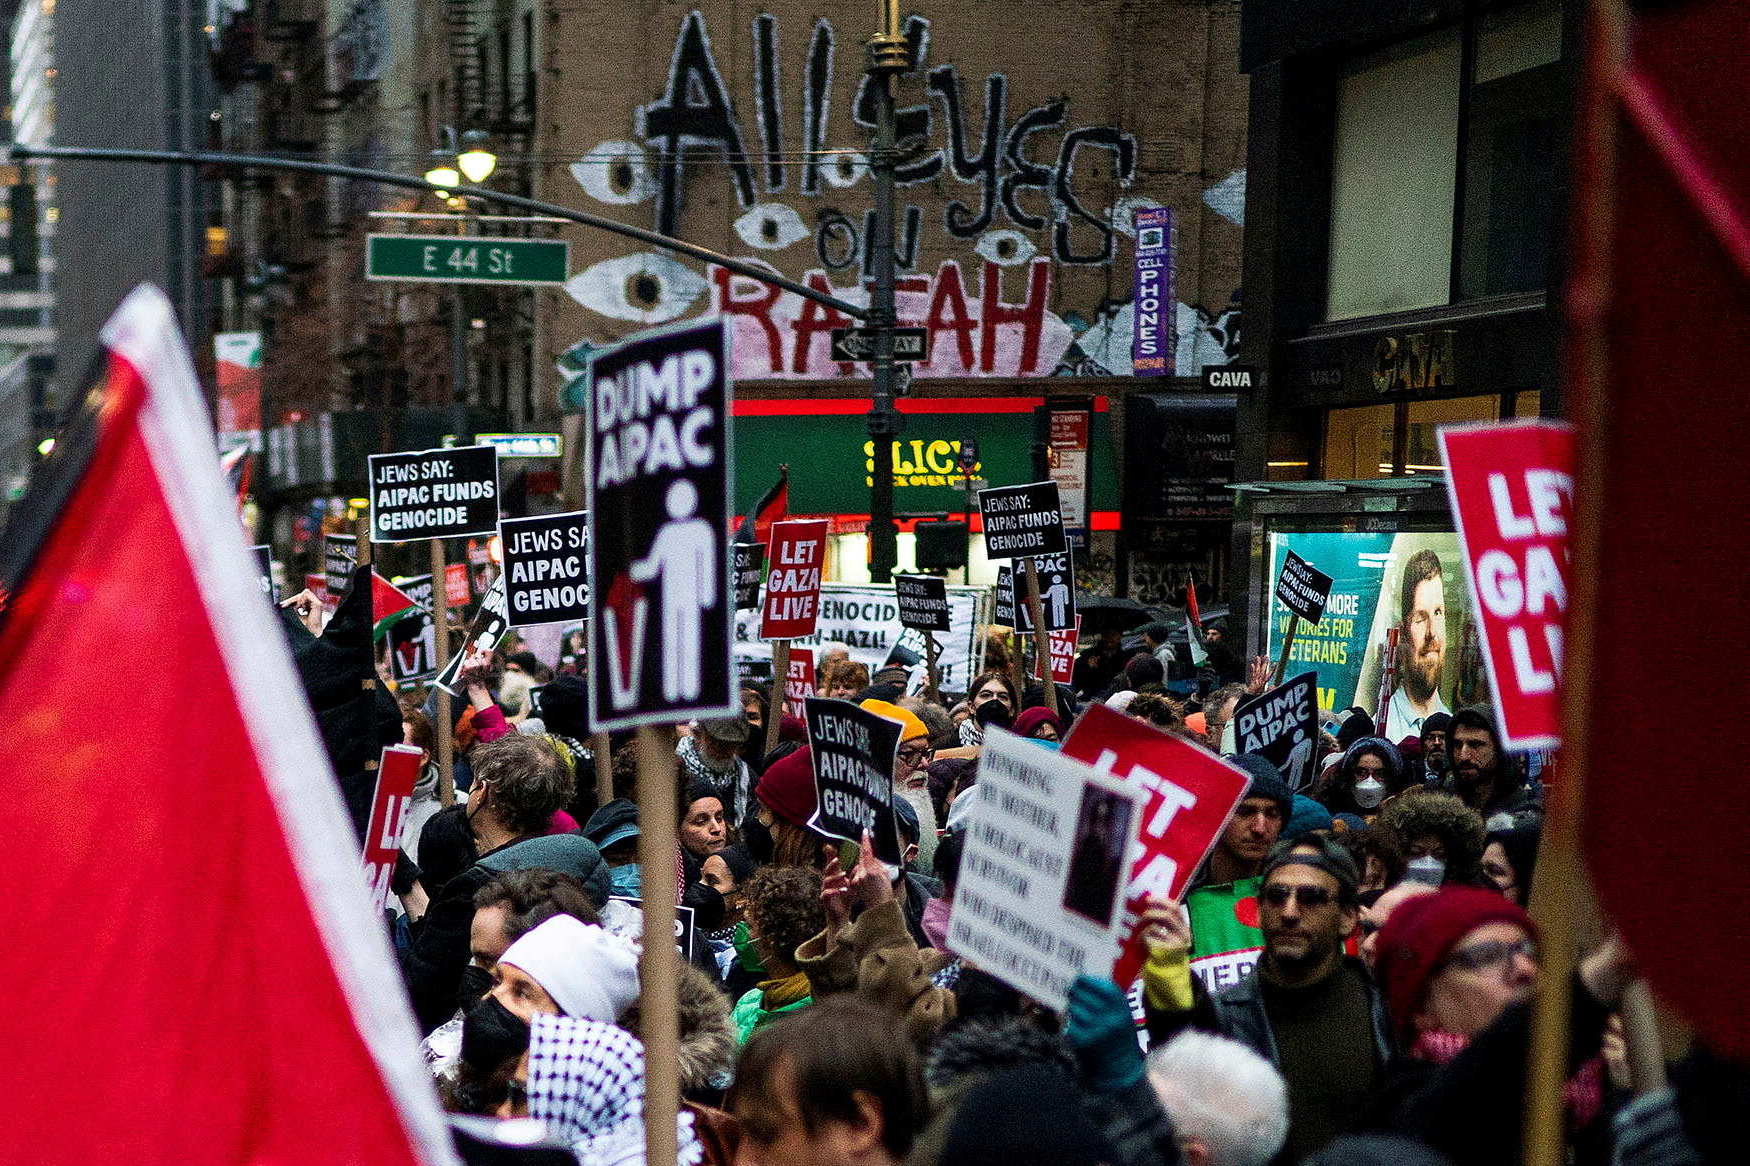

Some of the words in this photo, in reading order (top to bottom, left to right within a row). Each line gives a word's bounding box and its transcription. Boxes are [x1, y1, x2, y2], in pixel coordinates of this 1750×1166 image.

[423, 245, 438, 272] E
[447, 247, 479, 273] 44
[488, 247, 514, 274] St
[1139, 270, 1160, 355] PHONES
[596, 349, 717, 432] DUMP
[1209, 371, 1251, 388] CAVA
[376, 464, 419, 485] JEWS
[420, 460, 454, 480] SAY:
[378, 485, 430, 508] AIPAC
[433, 480, 495, 503] FUNDS
[984, 497, 1009, 513] JEWS
[1009, 494, 1031, 511] SAY:
[378, 506, 468, 532] GENOCIDE
[987, 516, 1017, 532] AIPAC
[1018, 510, 1060, 528] FUNDS
[508, 528, 563, 555] JEWS
[780, 540, 818, 565] LET
[989, 532, 1045, 551] GENOCIDE
[511, 556, 582, 584] AIPAC
[1016, 557, 1068, 575] APAC
[768, 567, 820, 593] GAZA
[513, 584, 591, 612] GENOC
[769, 594, 815, 621] LIVE
[919, 598, 947, 611] FUNDS
[1297, 583, 1326, 607] FUNDS
[1326, 594, 1361, 616] MORE
[816, 600, 896, 622] ENOCID
[1279, 615, 1330, 637] VITORIES
[1331, 619, 1354, 639] FOR
[1282, 638, 1349, 665] ETERANS
[786, 680, 815, 699] AZA
[1239, 681, 1309, 737] DUMP
[815, 714, 855, 747] JEWS
[1244, 700, 1310, 754] AIPAC
[820, 751, 865, 789] AIPAC
